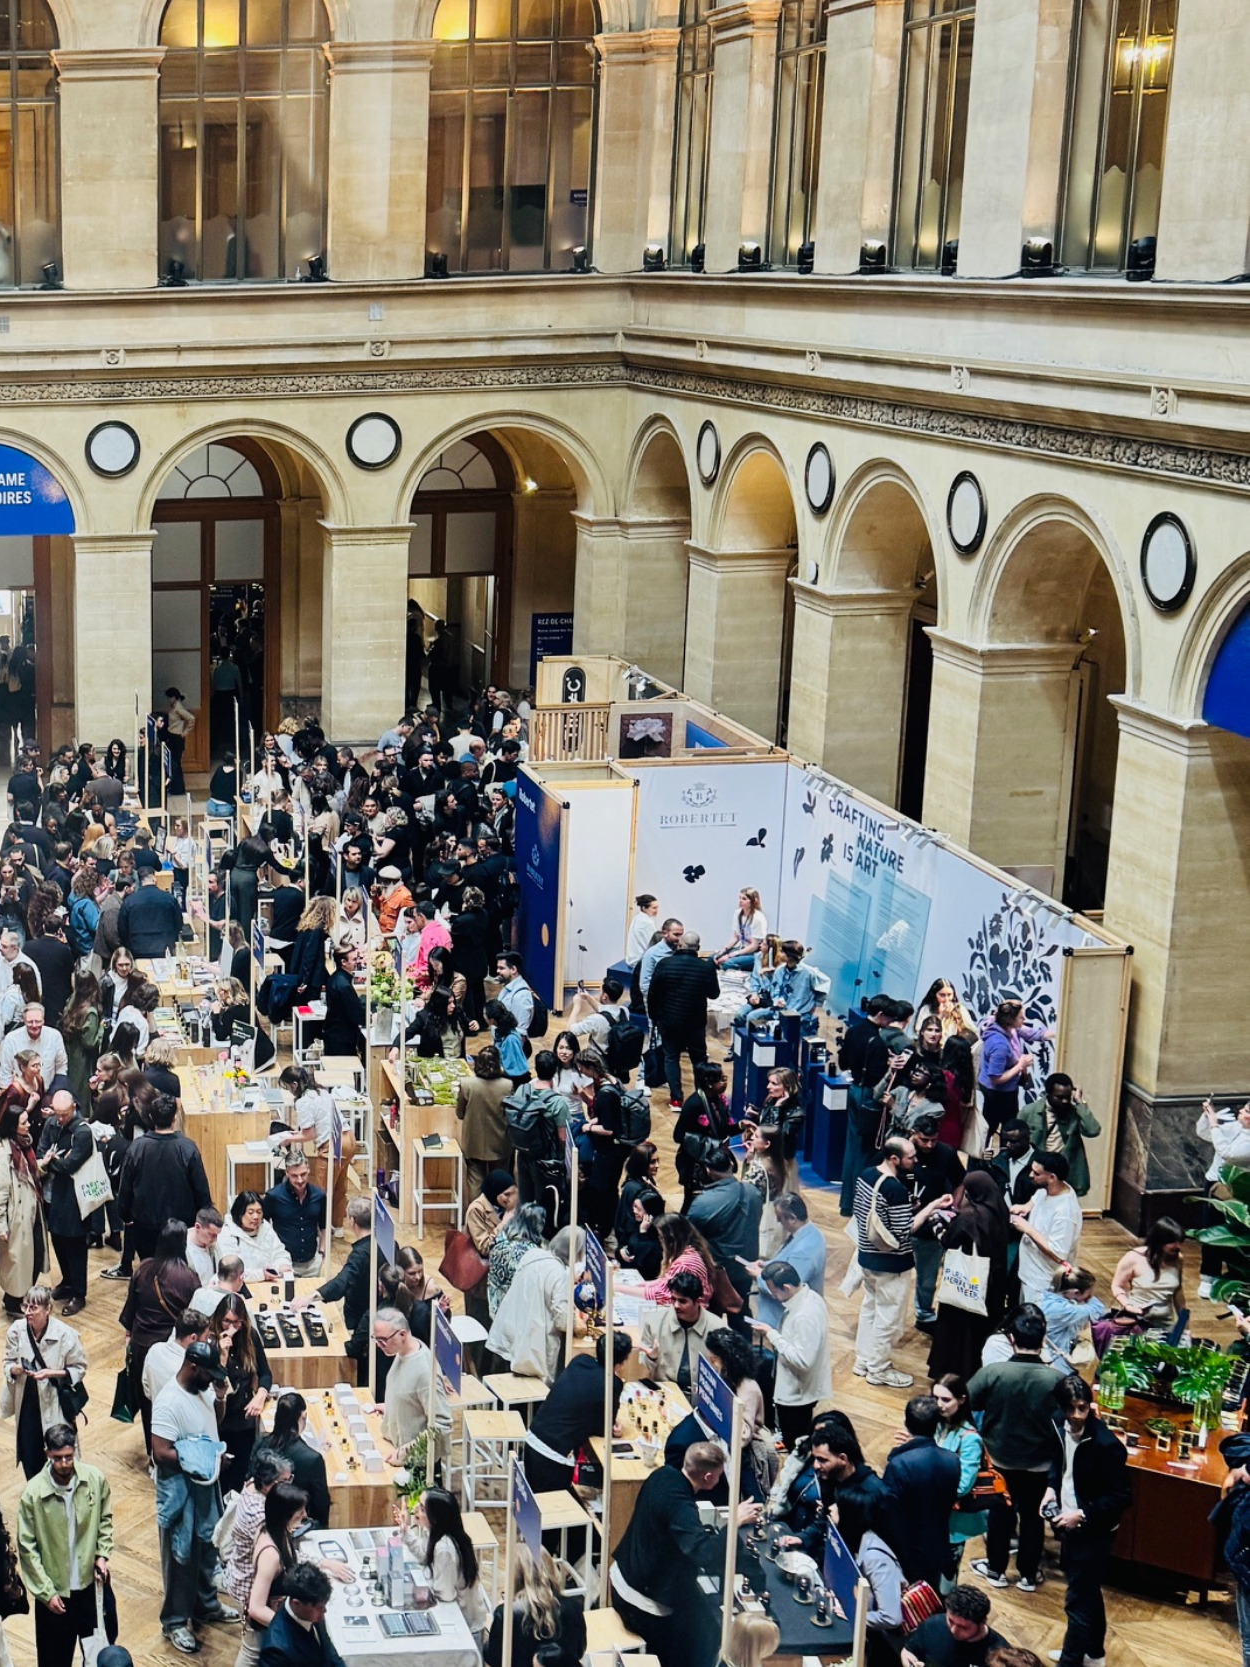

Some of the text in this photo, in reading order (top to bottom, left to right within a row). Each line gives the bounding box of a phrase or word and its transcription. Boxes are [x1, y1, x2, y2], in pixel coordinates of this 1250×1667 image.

[660, 812, 738, 825] ROBERTET
[829, 799, 886, 842] CRAFTING
[843, 842, 879, 878] IS ART
[857, 832, 905, 874] NATURE
